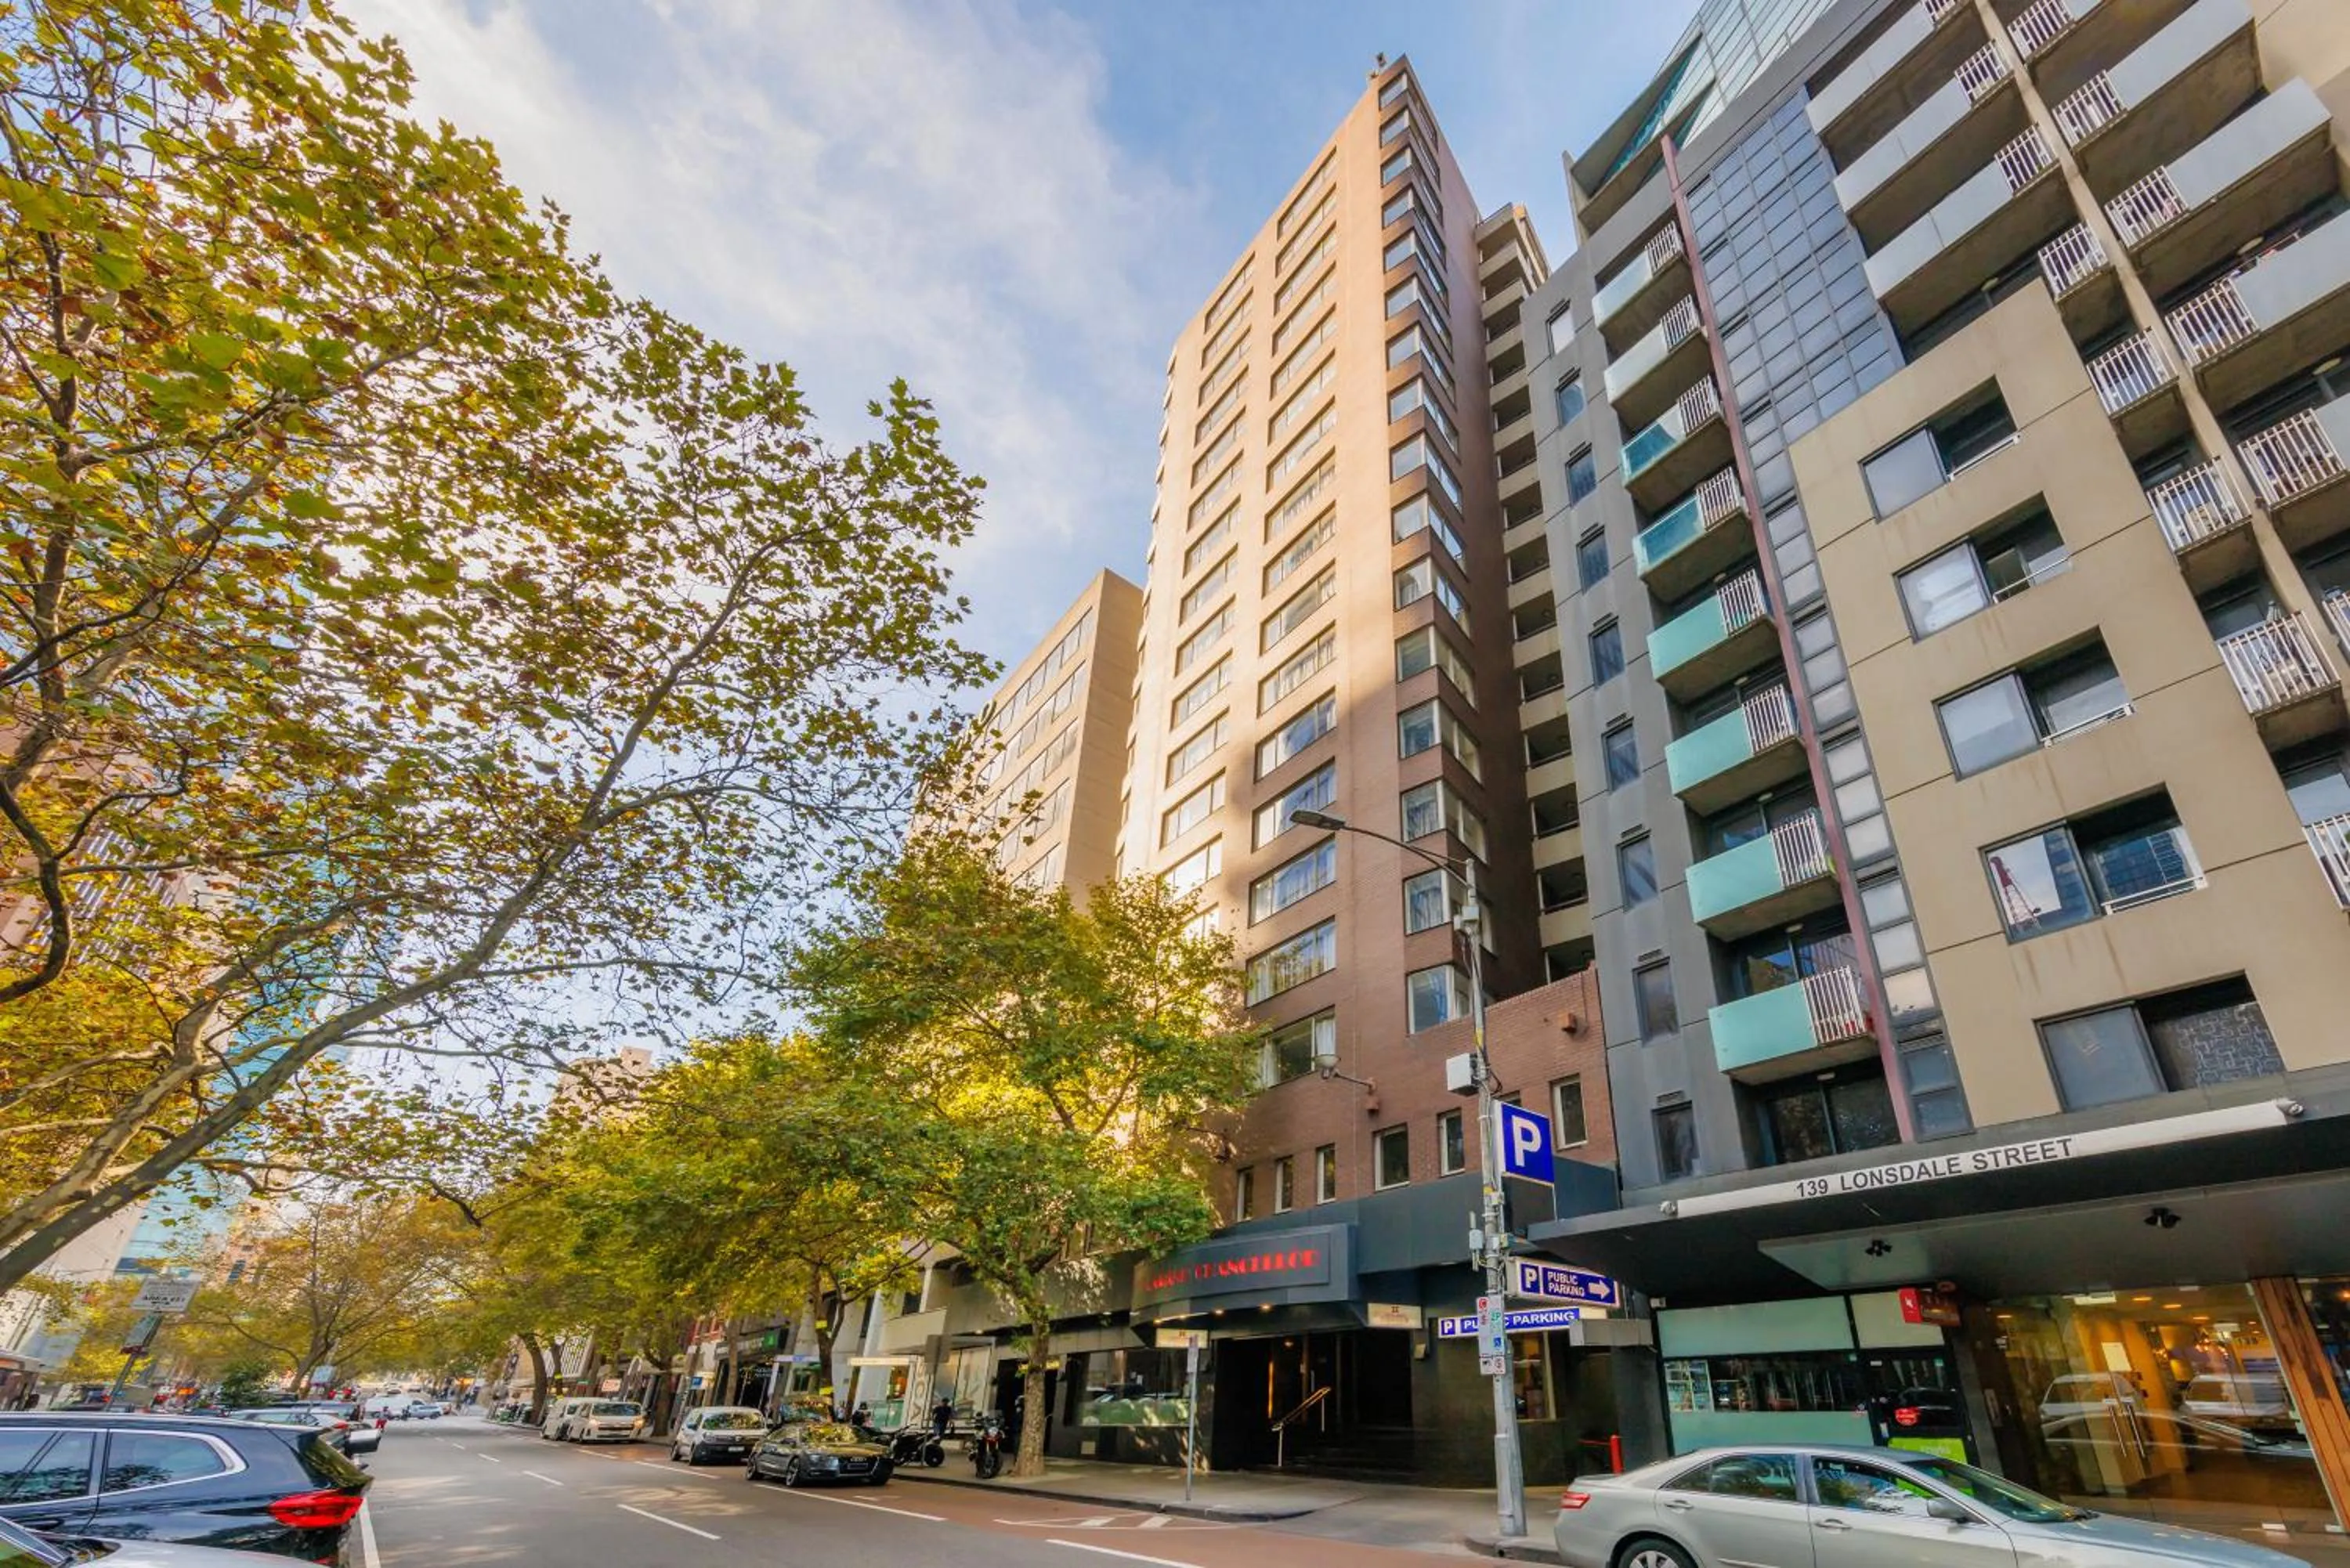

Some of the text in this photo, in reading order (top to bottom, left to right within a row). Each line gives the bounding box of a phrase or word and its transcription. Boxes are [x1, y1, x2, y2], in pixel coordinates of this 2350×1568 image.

[1511, 1115, 1542, 1167] P
[1797, 1138, 2073, 1198] 139 LONSDALE STREET
[1524, 1267, 1537, 1289] P
[1547, 1271, 1578, 1285] PUBLIC
[1548, 1282, 1585, 1298] PARKING
[1513, 1311, 1575, 1325] PARKING
[1444, 1321, 1453, 1335] P
